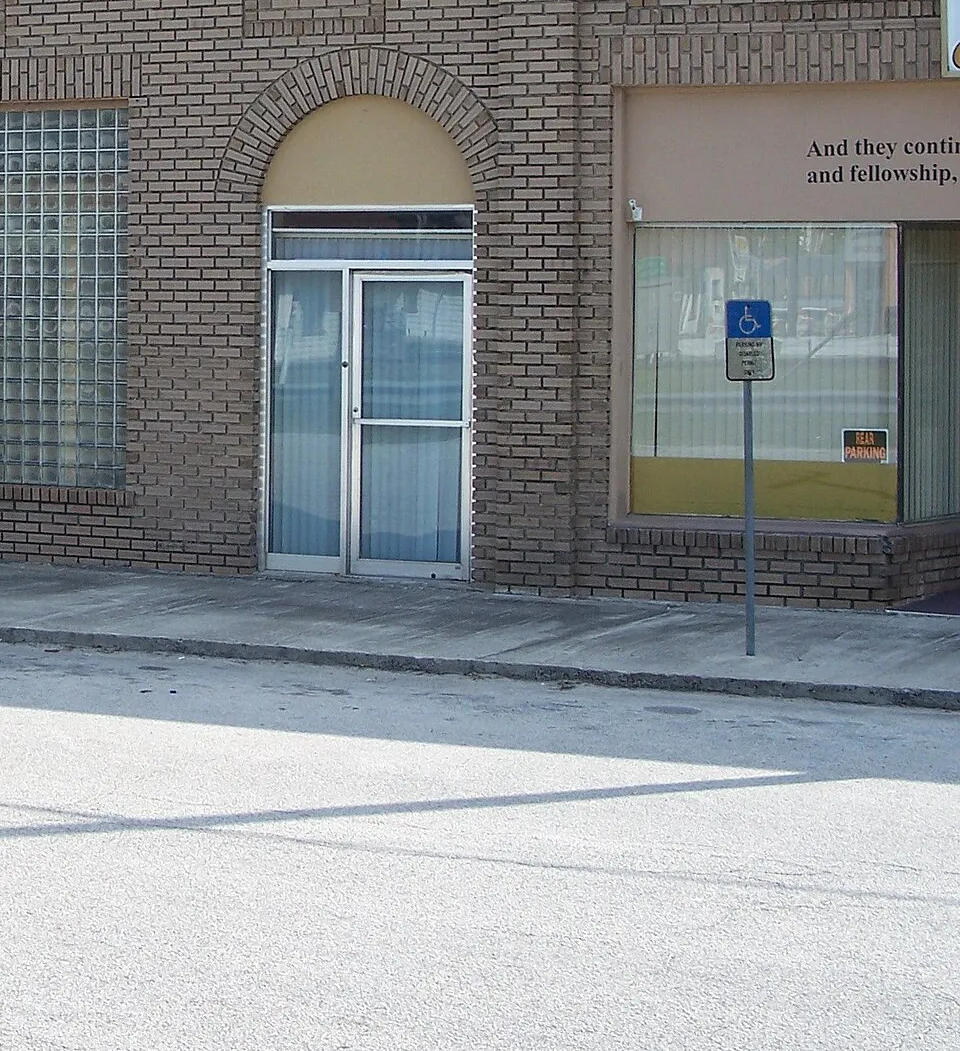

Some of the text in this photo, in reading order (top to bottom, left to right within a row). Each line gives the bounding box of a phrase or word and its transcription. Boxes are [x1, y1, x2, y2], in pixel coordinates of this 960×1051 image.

[807, 139, 848, 157] And
[855, 138, 897, 159] they
[807, 164, 957, 186] and fellowship,
[845, 446, 886, 460] PARKING
